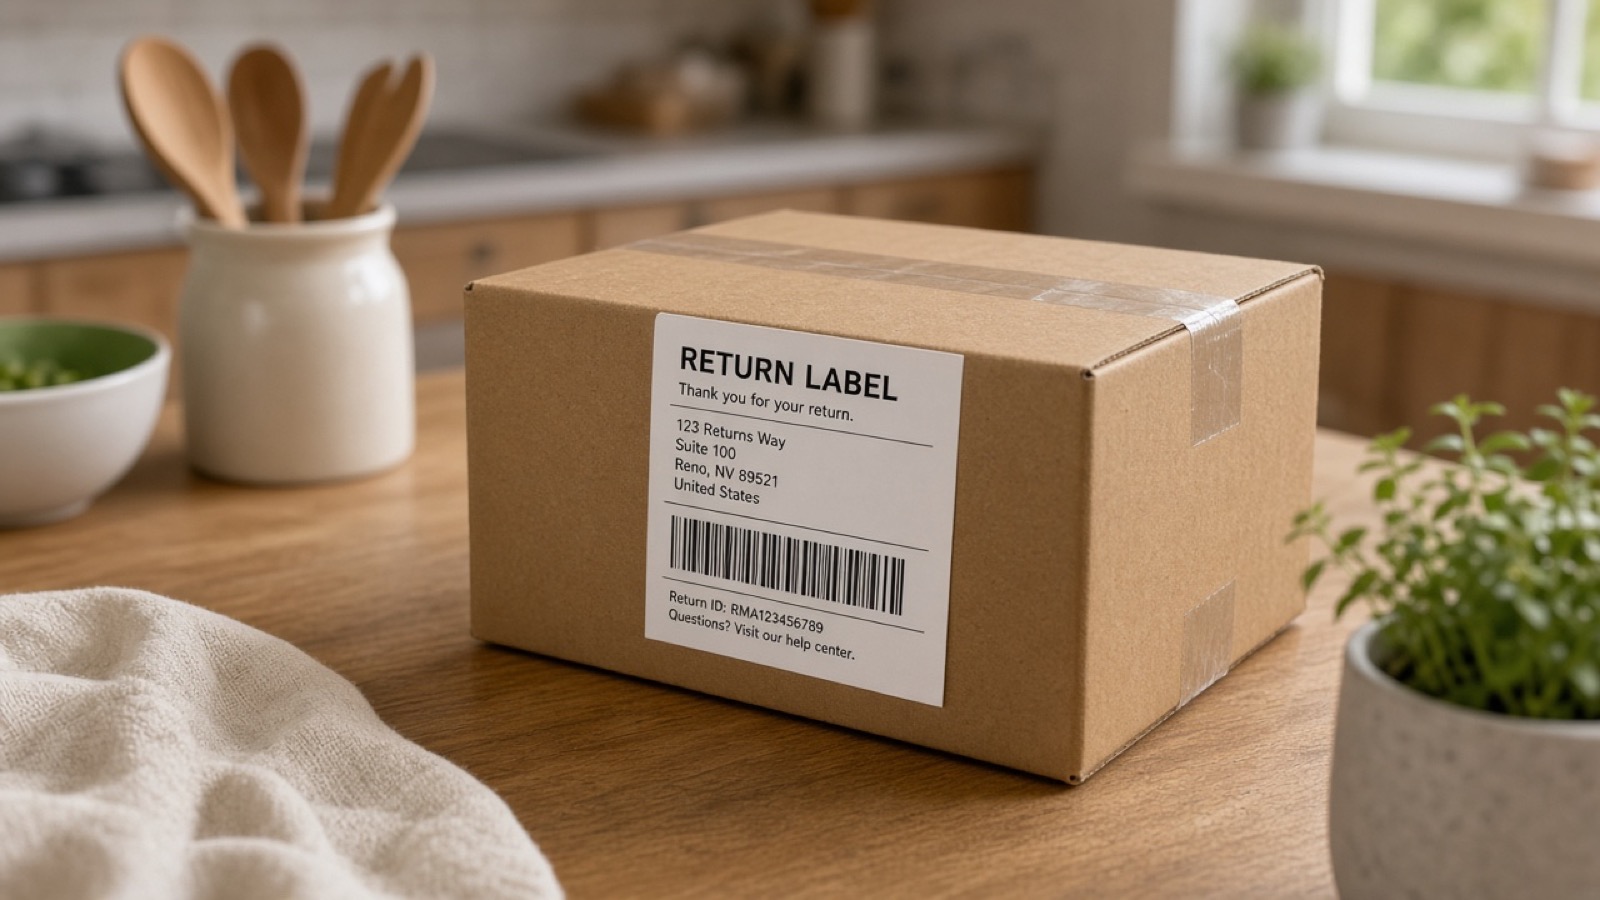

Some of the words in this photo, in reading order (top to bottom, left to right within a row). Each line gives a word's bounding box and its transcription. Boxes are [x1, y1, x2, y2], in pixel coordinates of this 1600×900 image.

[680, 346, 794, 386] RETURN
[805, 364, 898, 401] LABEL
[679, 382, 718, 400] Thank
[722, 390, 746, 405] you
[751, 393, 770, 407] for
[774, 399, 803, 414] your
[809, 404, 853, 422] return.
[676, 439, 708, 454] Suite
[713, 445, 736, 460] 100
[677, 419, 699, 433] 123
[704, 423, 753, 442] Returns
[758, 431, 786, 450] Way
[675, 458, 710, 478] Reno,
[716, 465, 734, 479] NV
[739, 469, 778, 487] 89521
[675, 477, 715, 496] United
[720, 486, 760, 504] States
[669, 591, 706, 608] Return
[711, 600, 726, 613] ID:
[731, 604, 823, 633] RMA123456789
[669, 609, 730, 631] Questions?
[735, 624, 759, 639] Visit
[763, 632, 782, 643] our
[786, 633, 810, 652] help
[815, 642, 855, 660] center.
